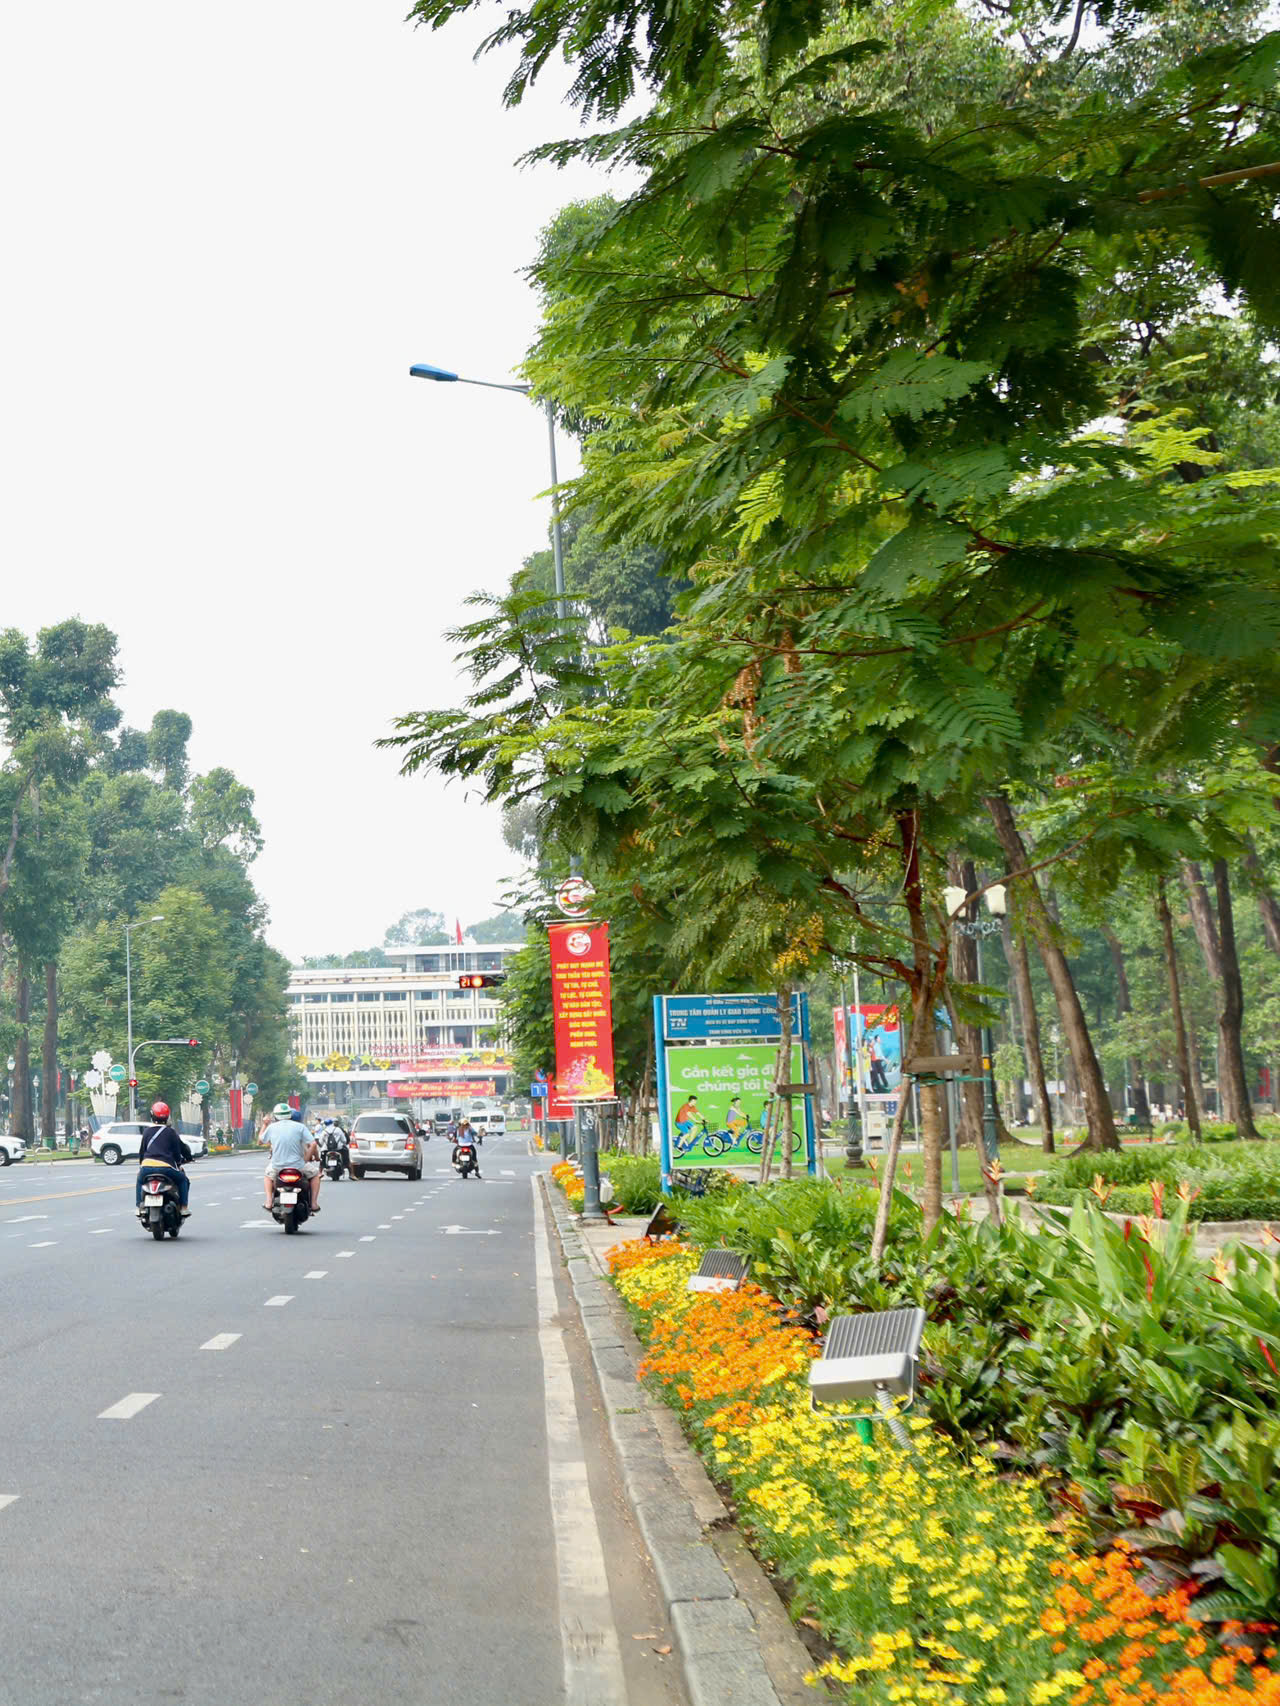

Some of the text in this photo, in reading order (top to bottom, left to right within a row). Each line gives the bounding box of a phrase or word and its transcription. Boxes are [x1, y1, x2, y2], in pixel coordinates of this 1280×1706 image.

[712, 1064, 734, 1077] kết
[737, 1064, 759, 1079] gia
[697, 1080, 740, 1093] chúng
[743, 1078, 760, 1090] tôi
